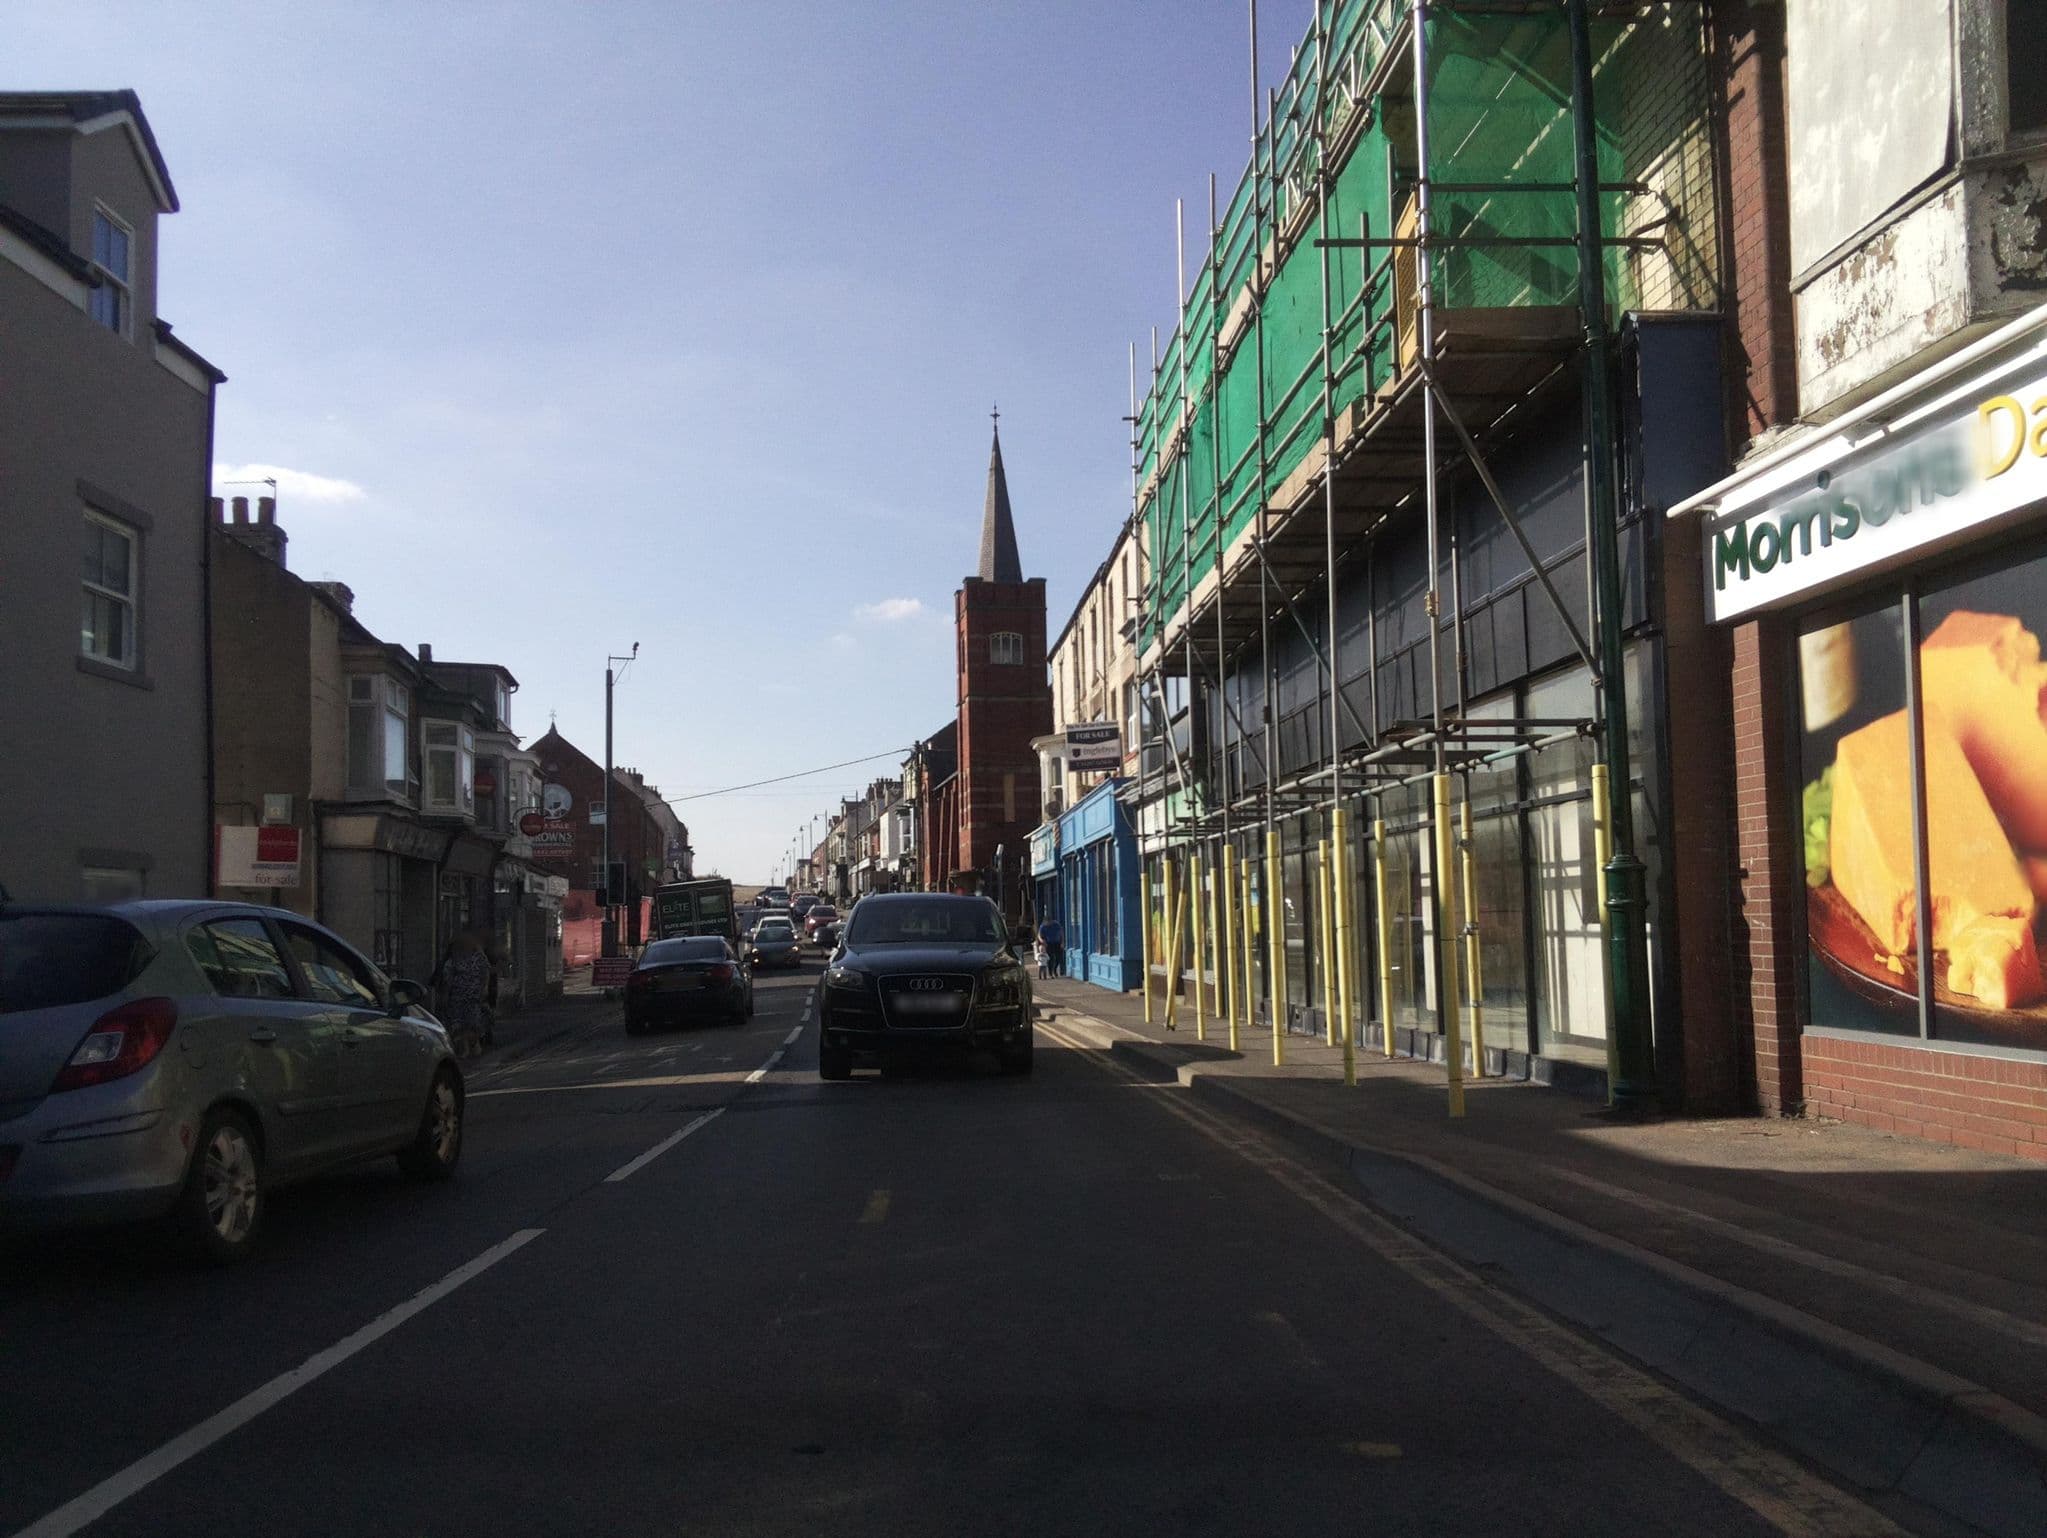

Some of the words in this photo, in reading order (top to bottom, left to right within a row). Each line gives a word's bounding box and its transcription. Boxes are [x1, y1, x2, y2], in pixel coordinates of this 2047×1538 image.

[1715, 436, 1966, 591] Morriso
[1090, 730, 1110, 738] SALE
[535, 831, 573, 842] ROWNS
[256, 873, 271, 885] for
[279, 873, 297, 886] sale
